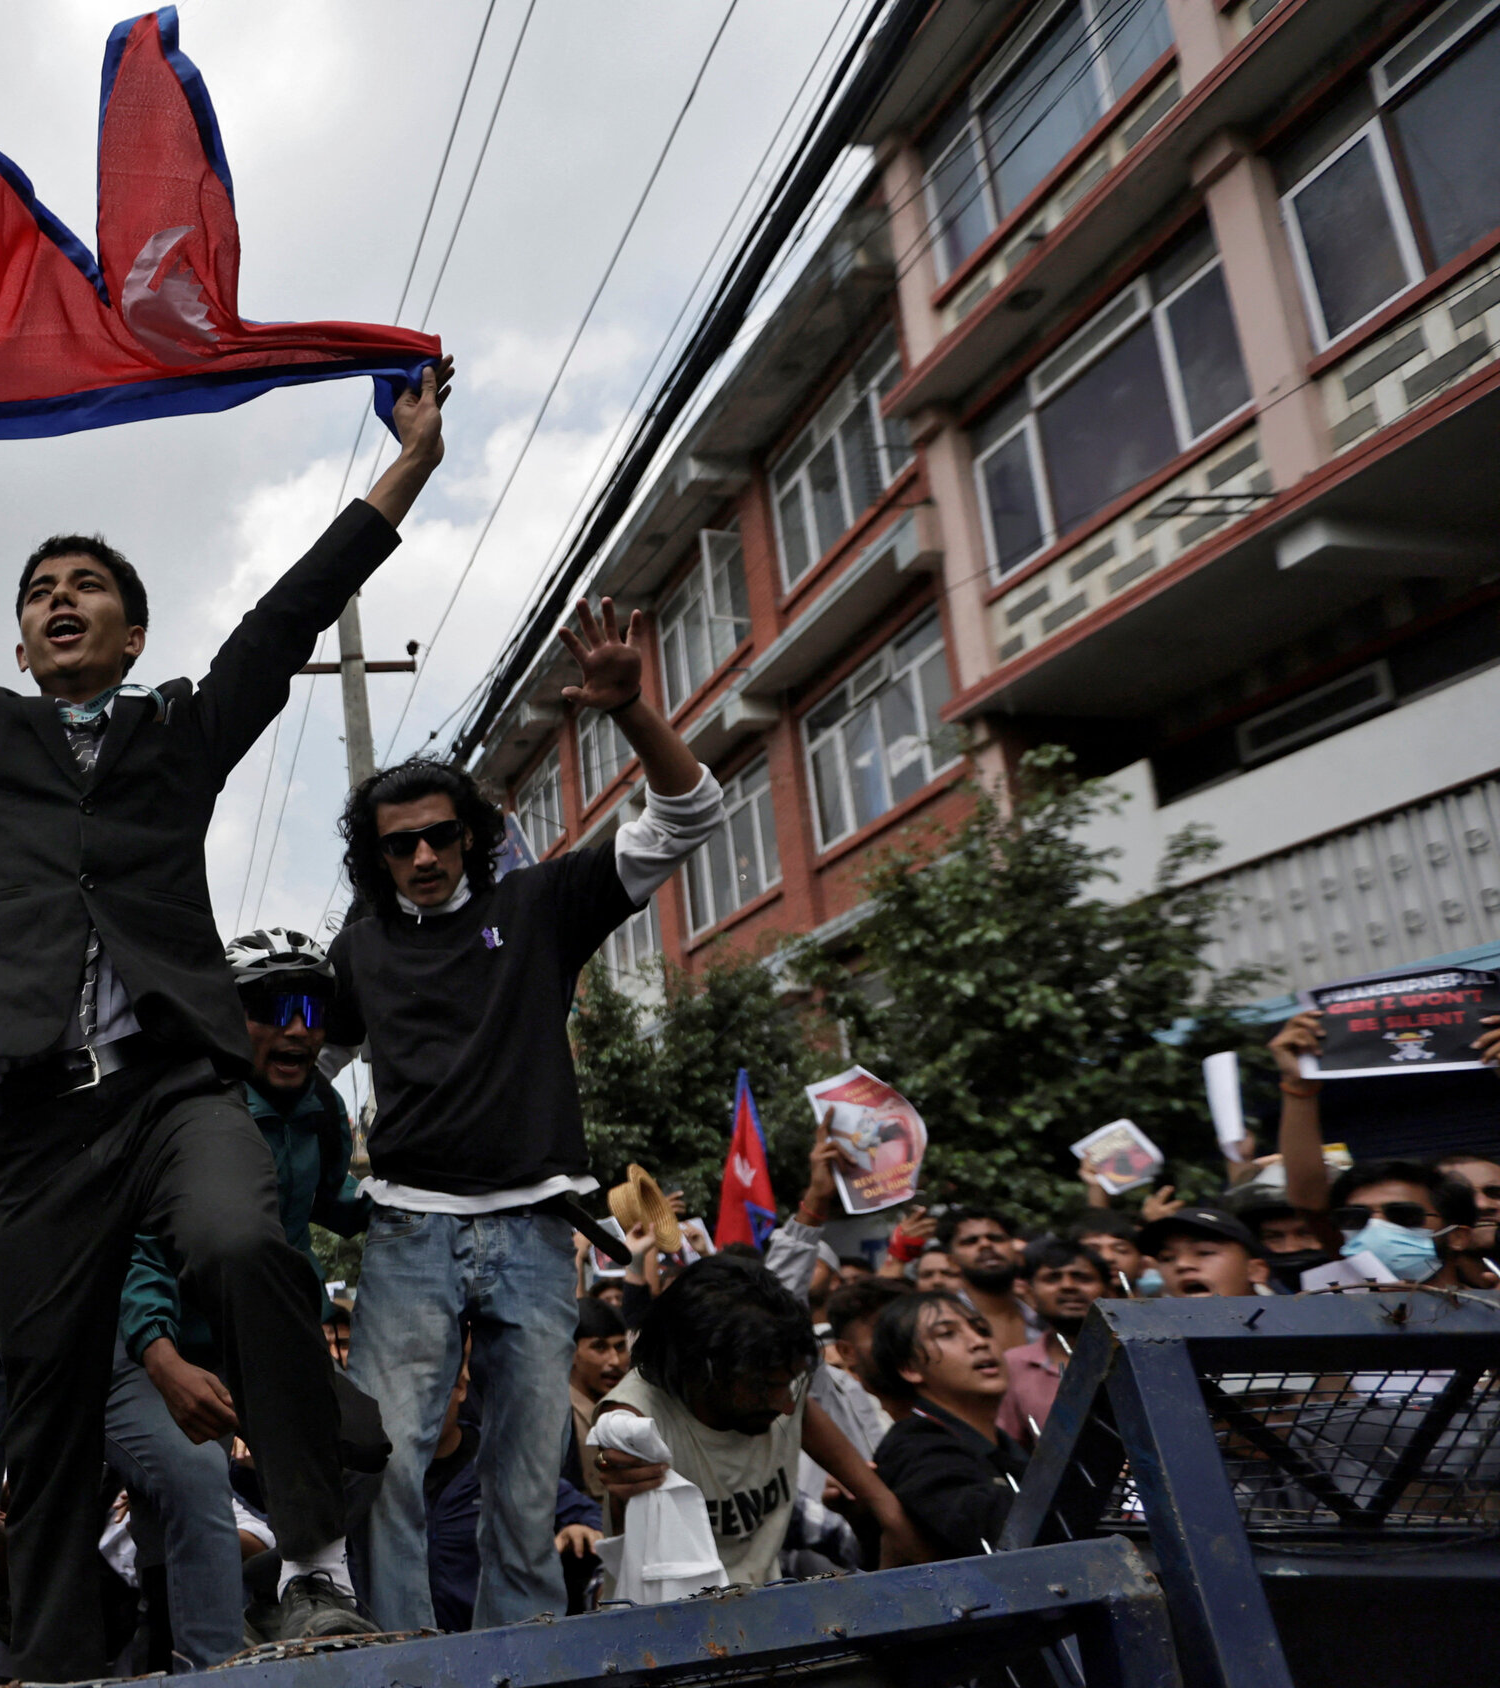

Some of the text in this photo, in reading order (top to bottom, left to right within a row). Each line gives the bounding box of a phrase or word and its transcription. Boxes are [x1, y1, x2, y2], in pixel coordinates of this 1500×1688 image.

[1326, 989, 1485, 1015] GEN Z WON'T
[1348, 1010, 1467, 1032] BE SILENT
